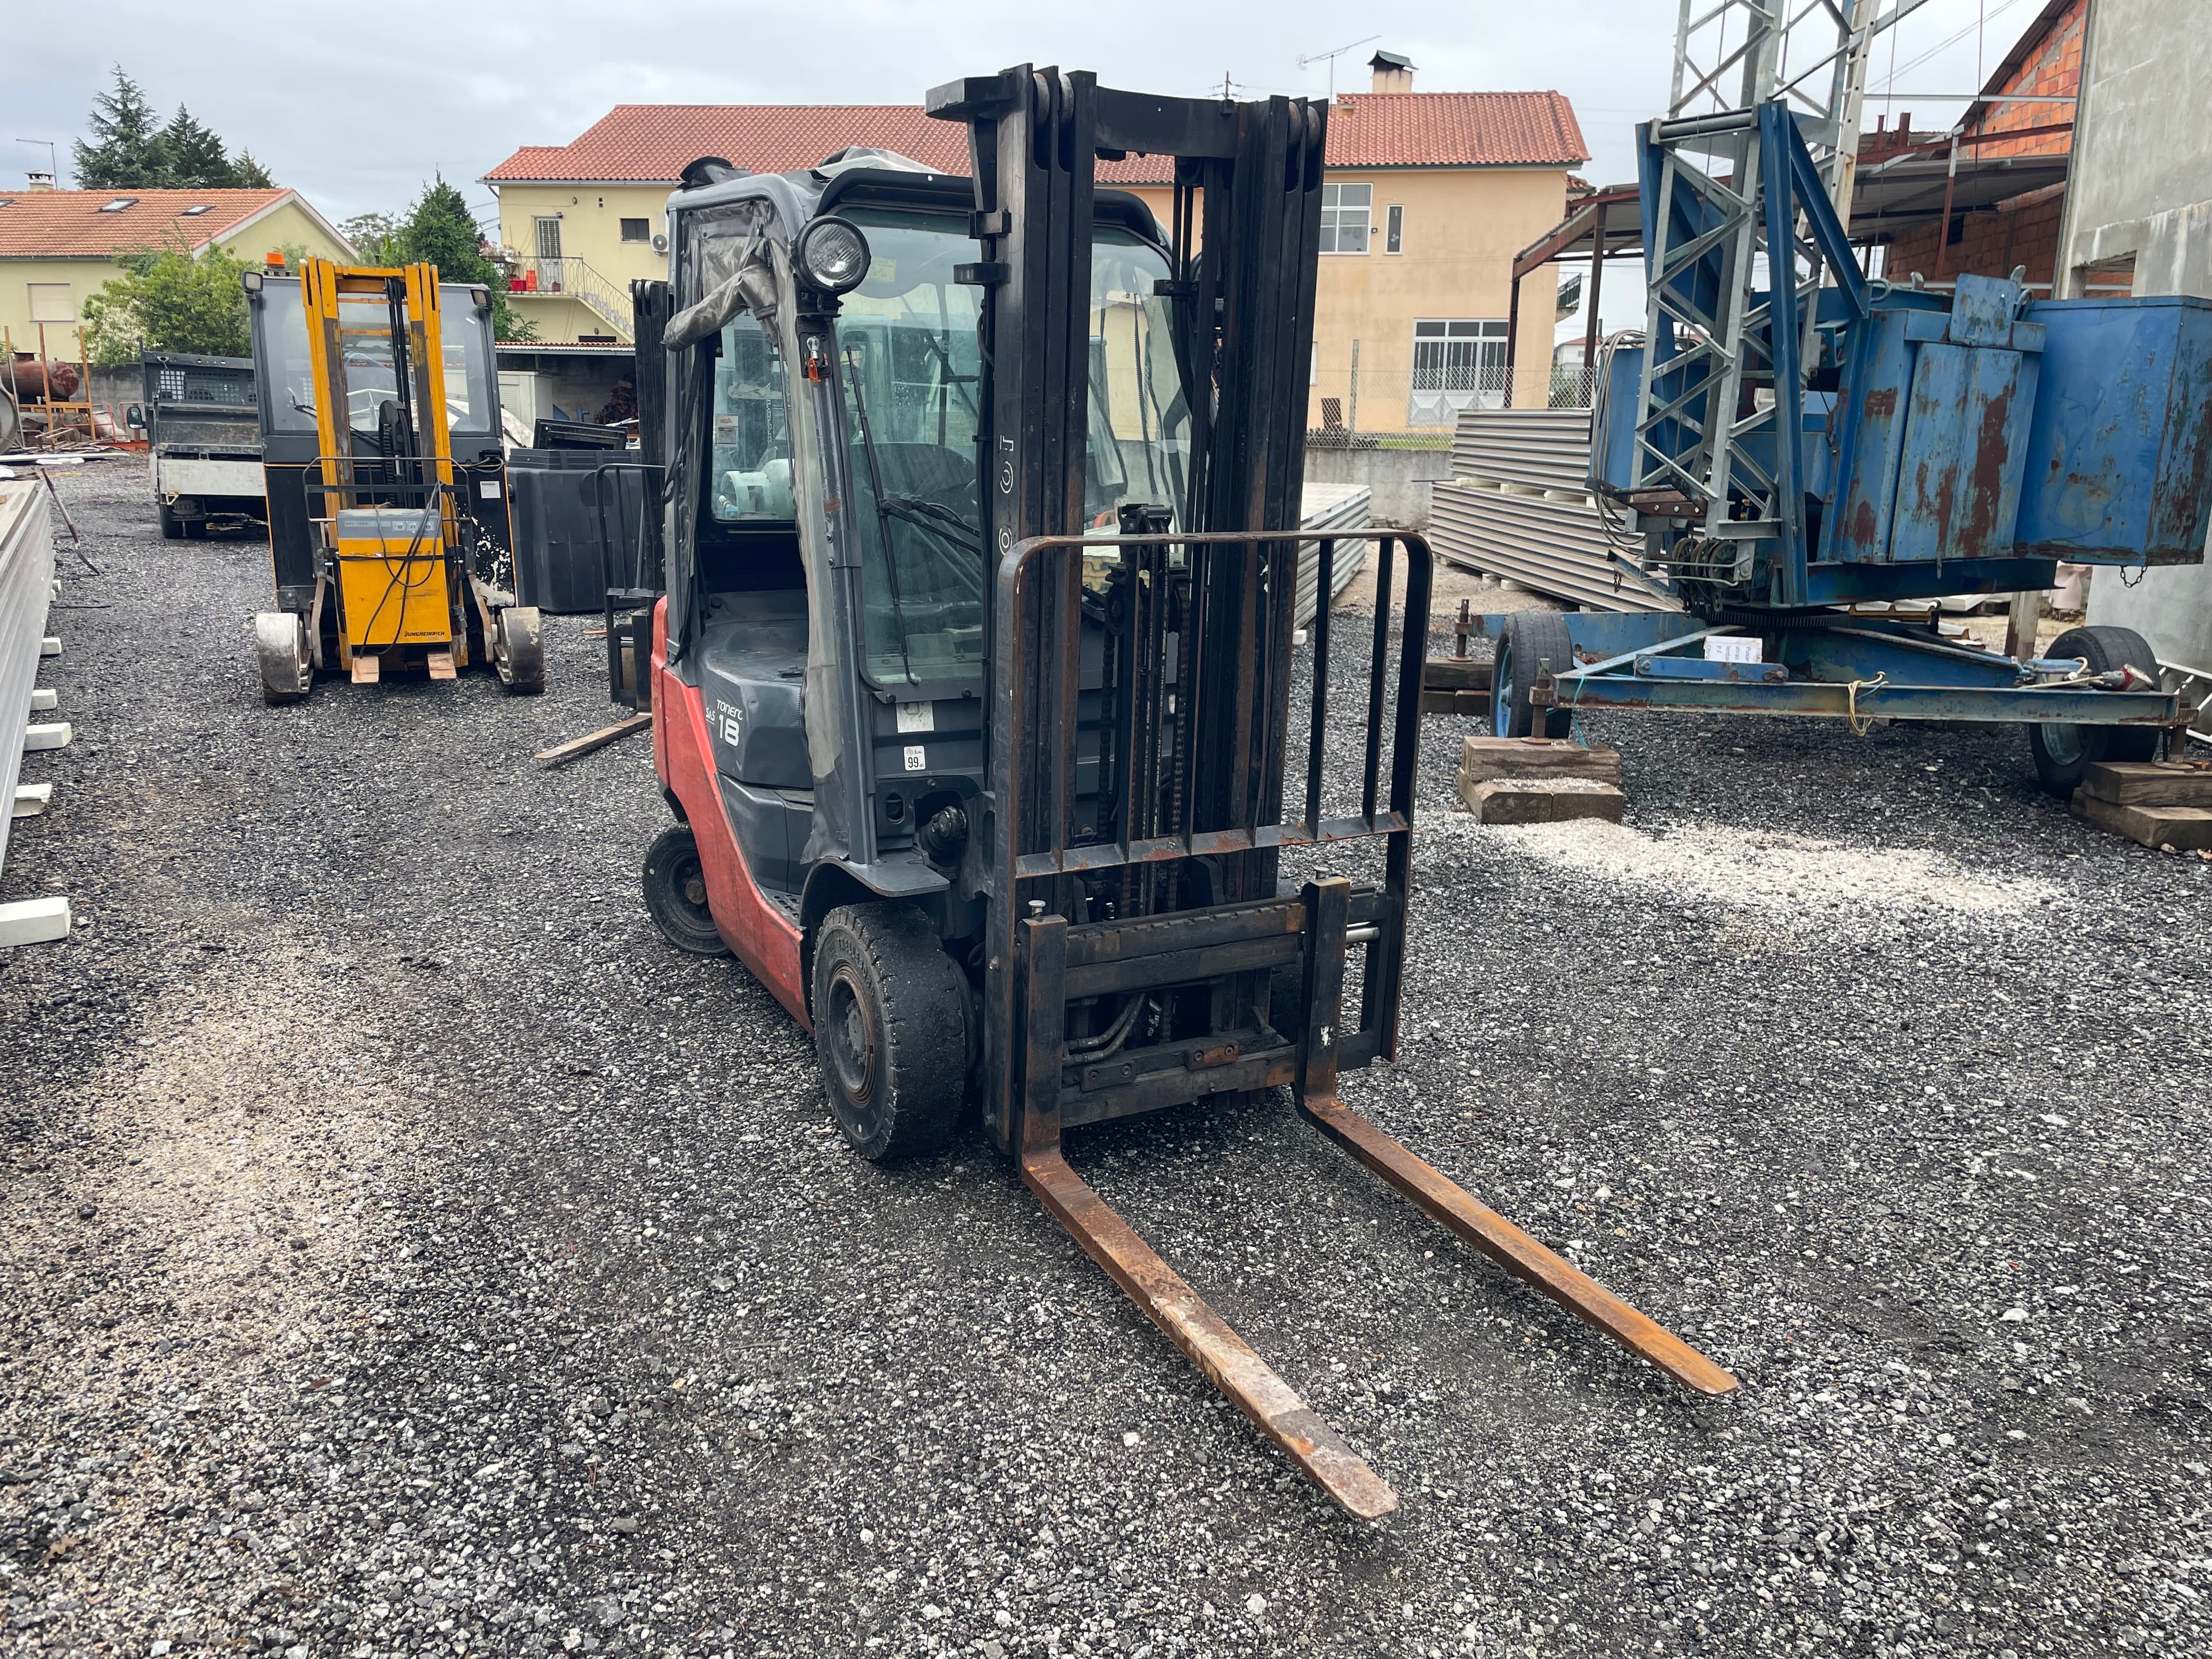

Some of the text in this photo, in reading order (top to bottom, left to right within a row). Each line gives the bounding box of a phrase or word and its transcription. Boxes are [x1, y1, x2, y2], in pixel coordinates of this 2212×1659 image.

[705, 706, 715, 722] SAS
[718, 714, 740, 747] 18
[908, 756, 919, 768] 99
